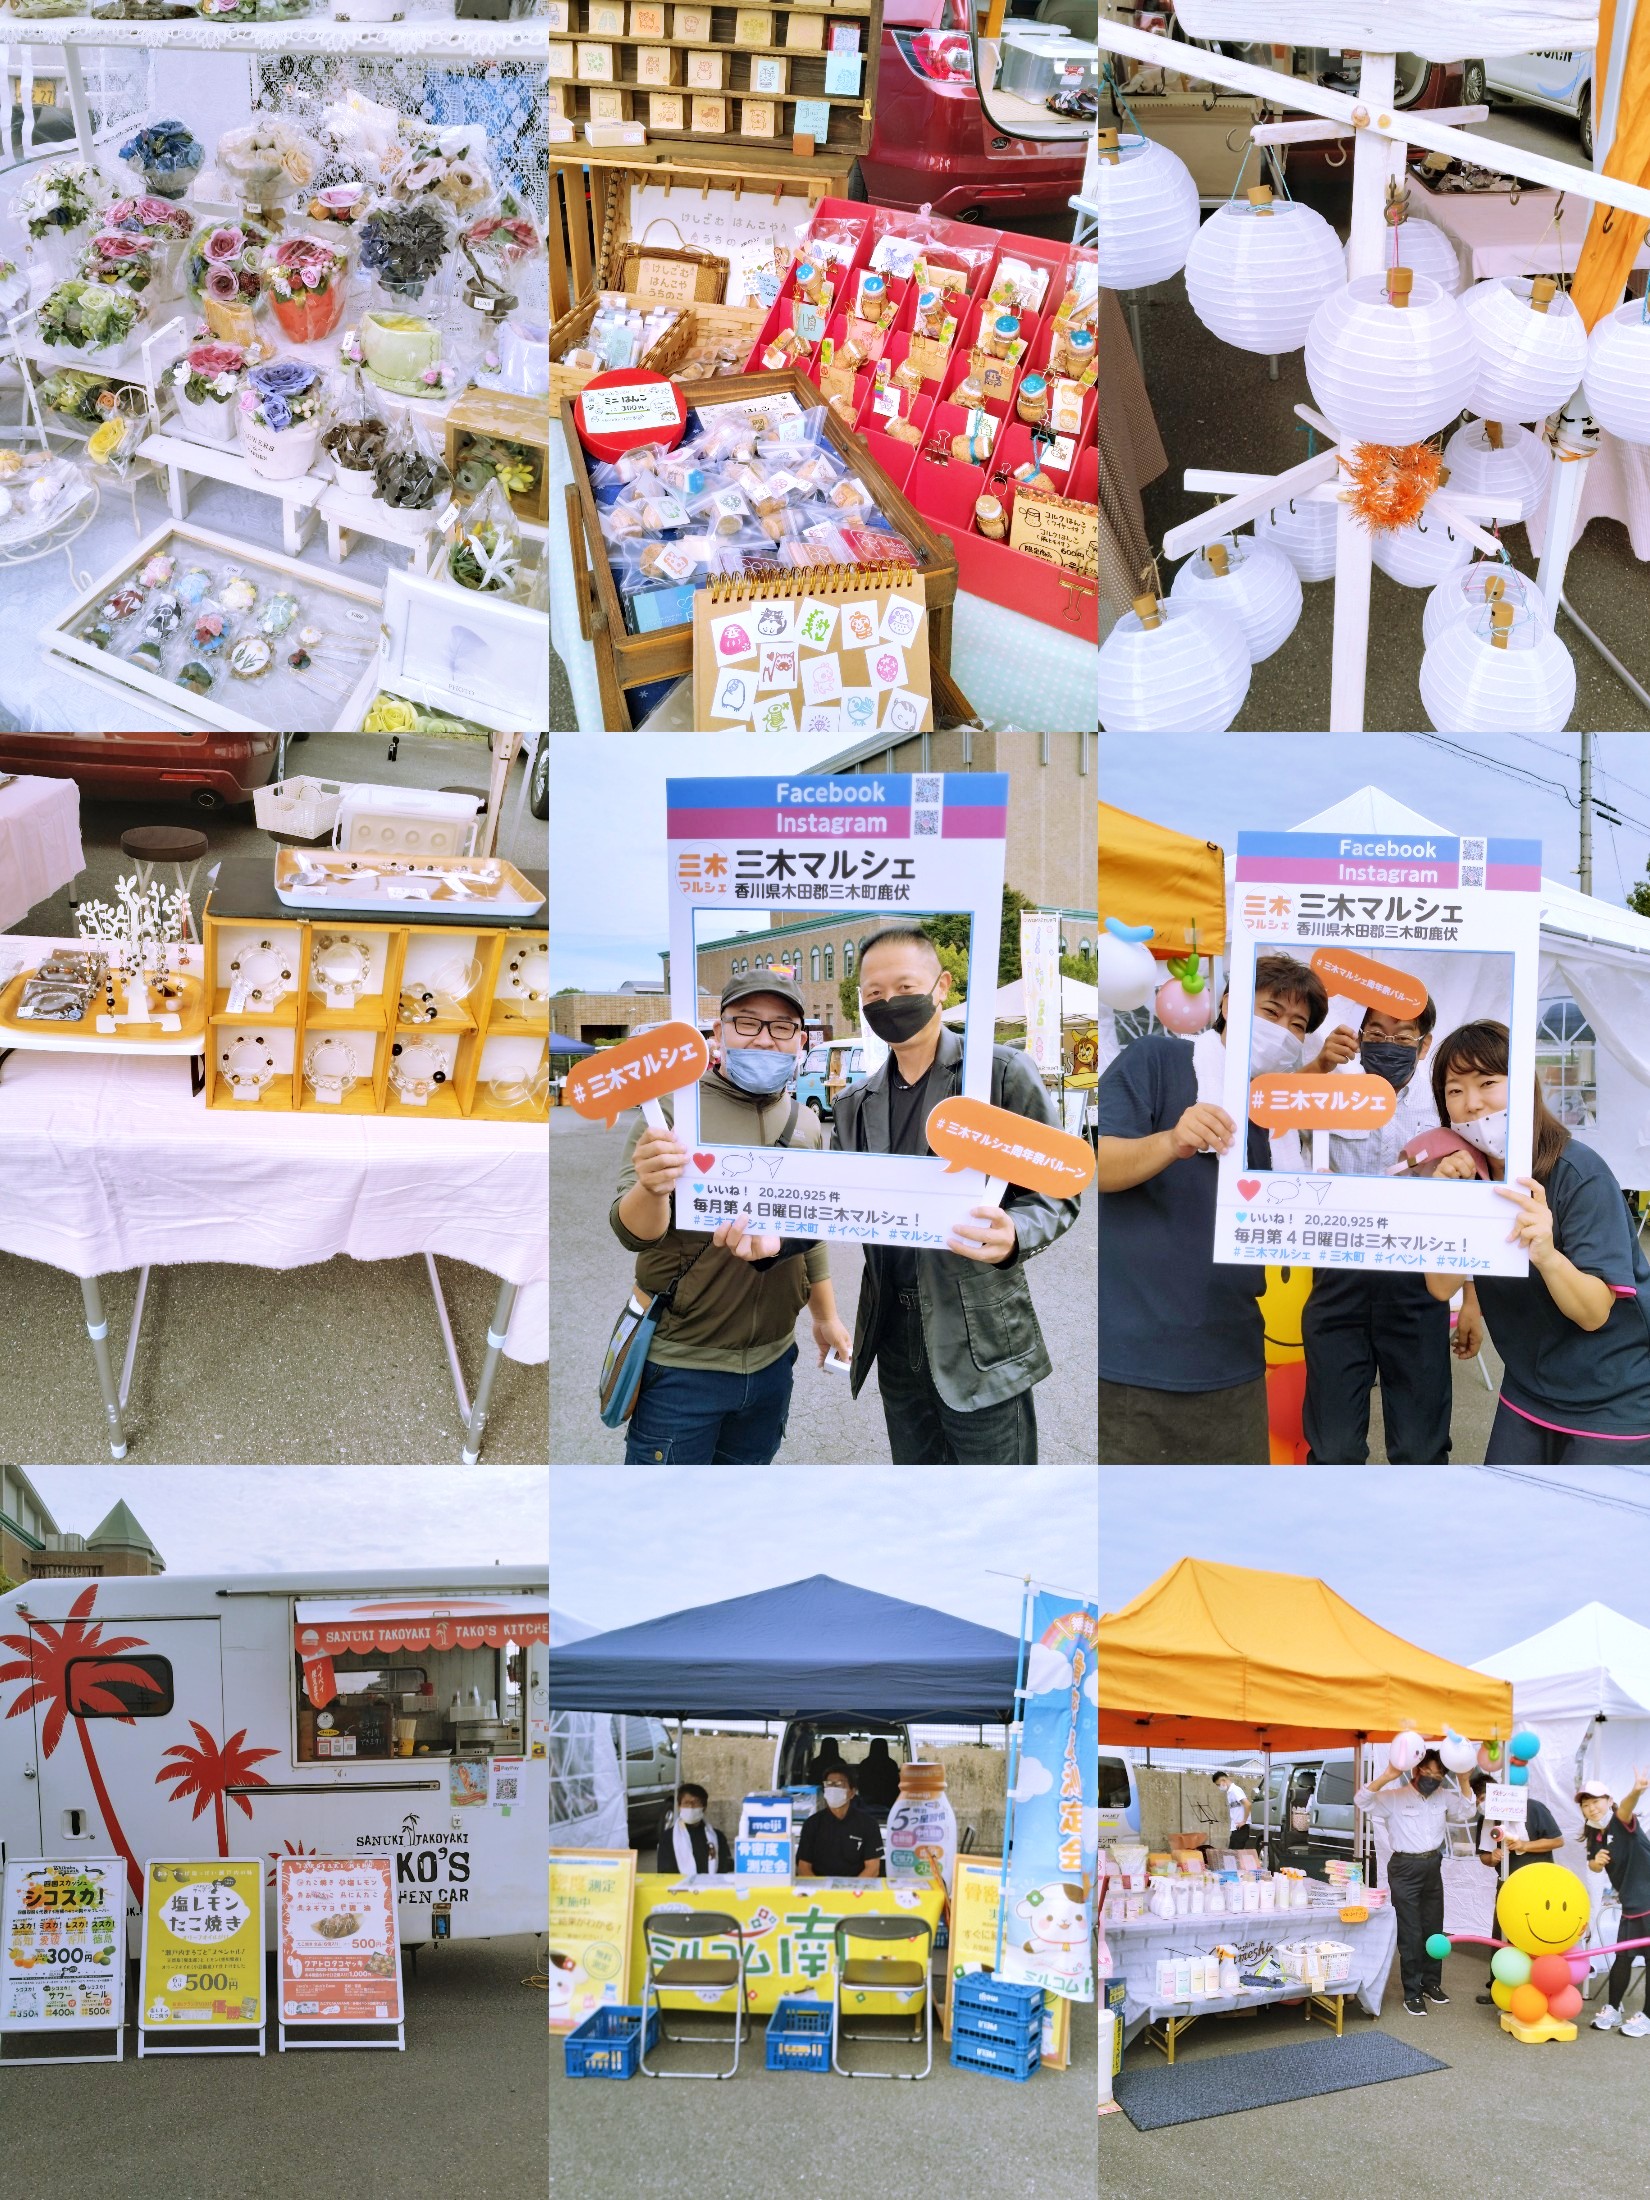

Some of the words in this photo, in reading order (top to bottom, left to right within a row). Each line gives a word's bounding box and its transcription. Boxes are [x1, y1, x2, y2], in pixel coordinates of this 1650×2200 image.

[681, 212, 725, 226] けしごむ
[732, 217, 780, 232] はんこや
[702, 233, 737, 247] うちの
[652, 263, 689, 278] けしごむ
[649, 276, 688, 289] はんこや
[648, 288, 685, 301] うちのこ
[604, 397, 619, 405] ミニ
[776, 781, 886, 803] Facebook
[776, 812, 888, 835] Instagram
[1339, 839, 1437, 858] Facebook
[678, 852, 729, 878] 三木
[734, 848, 916, 881] 三木マルシェ
[1338, 863, 1438, 884] Instagram
[679, 881, 728, 893] マルシェ
[734, 882, 911, 901] 香川県木田郡三木町鹿伏
[1244, 895, 1292, 917] 三木
[1297, 892, 1464, 924] 三木マルシェ
[1244, 918, 1290, 931] マルシェ
[1296, 921, 1459, 942] 香川県木田郡三木町鹿伏
[587, 1042, 698, 1099] 三木マルシェ
[1269, 1089, 1387, 1111] 三木マルシェ
[758, 1186, 827, 1202] 20,220,925
[829, 1191, 841, 1203] 件
[742, 1202, 753, 1216] 4
[1304, 1214, 1375, 1229] 20,220,925
[1377, 1217, 1389, 1230] 件
[1286, 1230, 1298, 1245] 4
[325, 1629, 375, 1643] SANUKI
[378, 1627, 431, 1641] TAKOYAKI
[455, 1624, 497, 1637] TAKO'S
[751, 1819, 782, 1832] meiji
[356, 1834, 405, 1847] SANUKI
[415, 1832, 469, 1846] TAKOYAKI
[737, 1842, 779, 1857] 骨密度
[746, 1859, 789, 1873] 測定会
[171, 1895, 239, 1912] 塩レモン
[438, 1888, 469, 1903] CAR
[169, 1915, 242, 1932] たこ焼き
[48, 1992, 73, 2000] サワー
[85, 1991, 108, 1999] ビール
